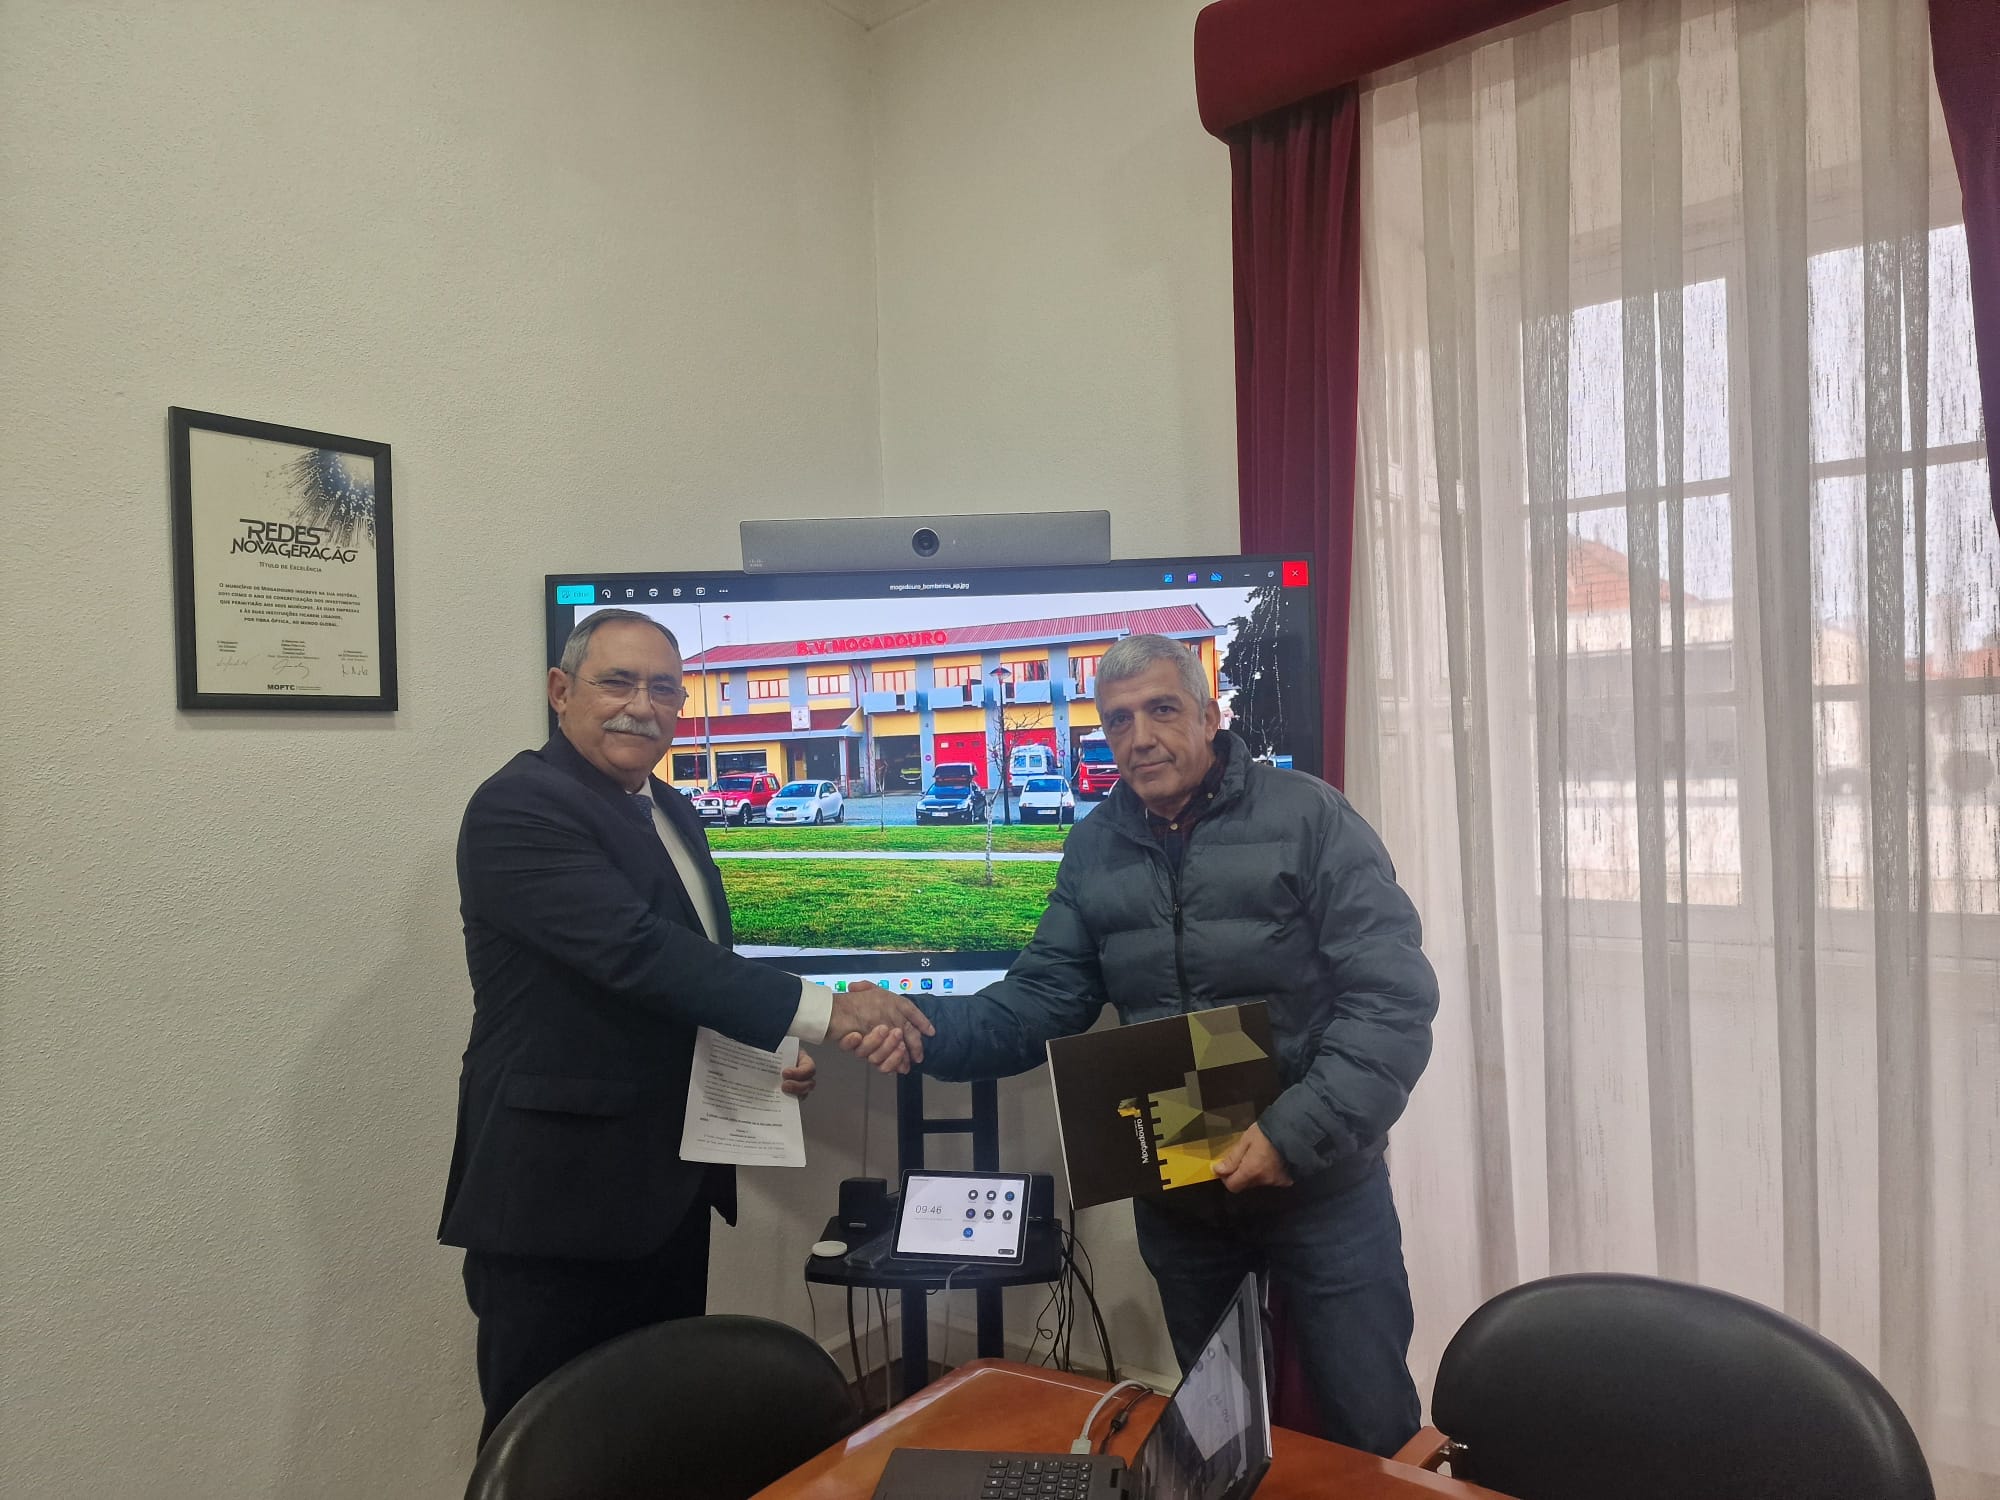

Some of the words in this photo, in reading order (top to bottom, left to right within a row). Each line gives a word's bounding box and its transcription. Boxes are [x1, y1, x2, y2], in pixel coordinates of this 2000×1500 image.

[240, 518, 331, 546] REDES
[259, 561, 279, 569] TÍTULO
[290, 564, 322, 572] EXCELÊNCIA
[832, 630, 947, 653] MOGADOURO
[1136, 1118, 1150, 1164] Mogadouro
[916, 1205, 942, 1214] 09:46
